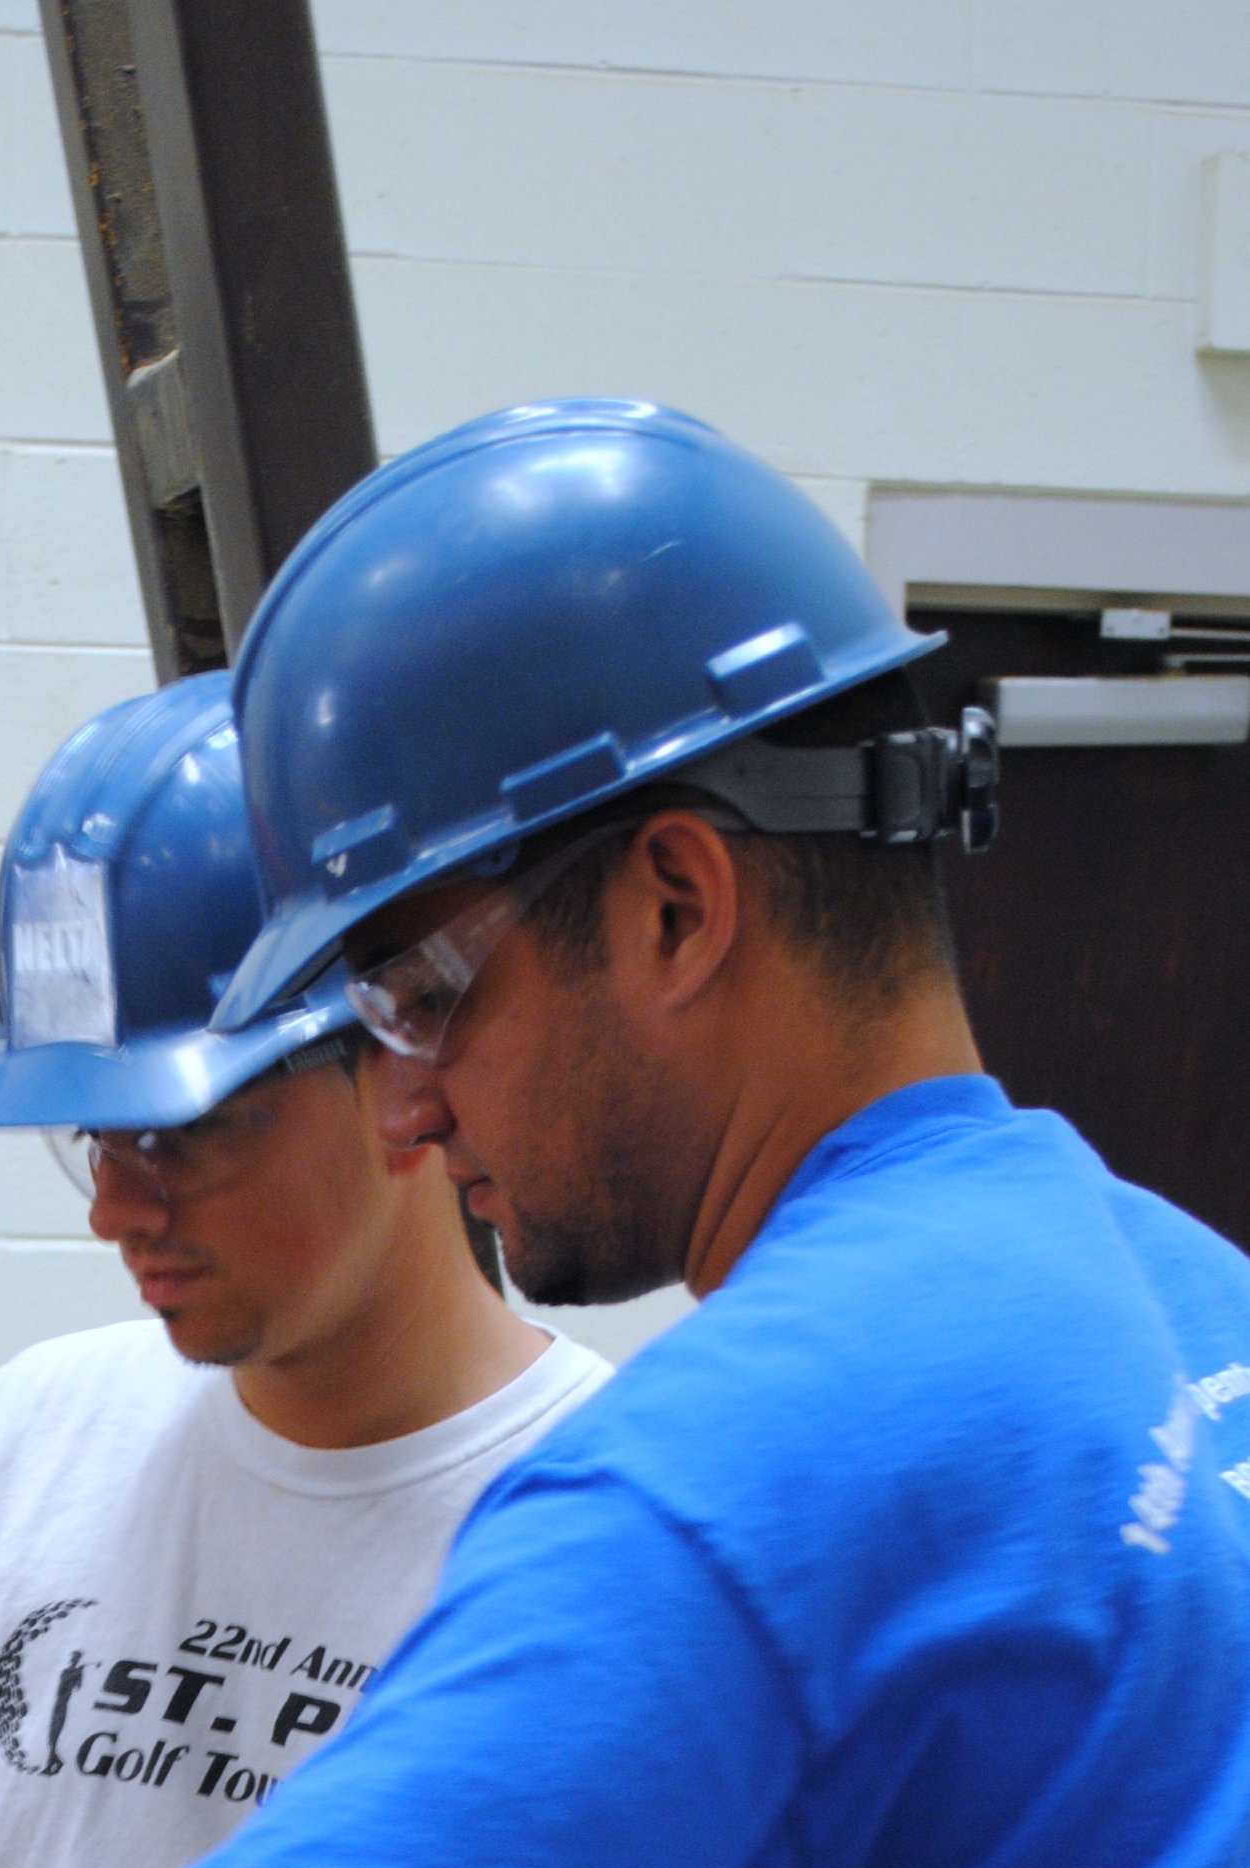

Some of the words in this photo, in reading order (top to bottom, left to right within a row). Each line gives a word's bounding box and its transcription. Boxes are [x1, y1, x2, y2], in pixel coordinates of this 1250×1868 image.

[177, 1618, 292, 1671] 22nd
[92, 1660, 237, 1733] ST.
[76, 1731, 189, 1787] Golf
